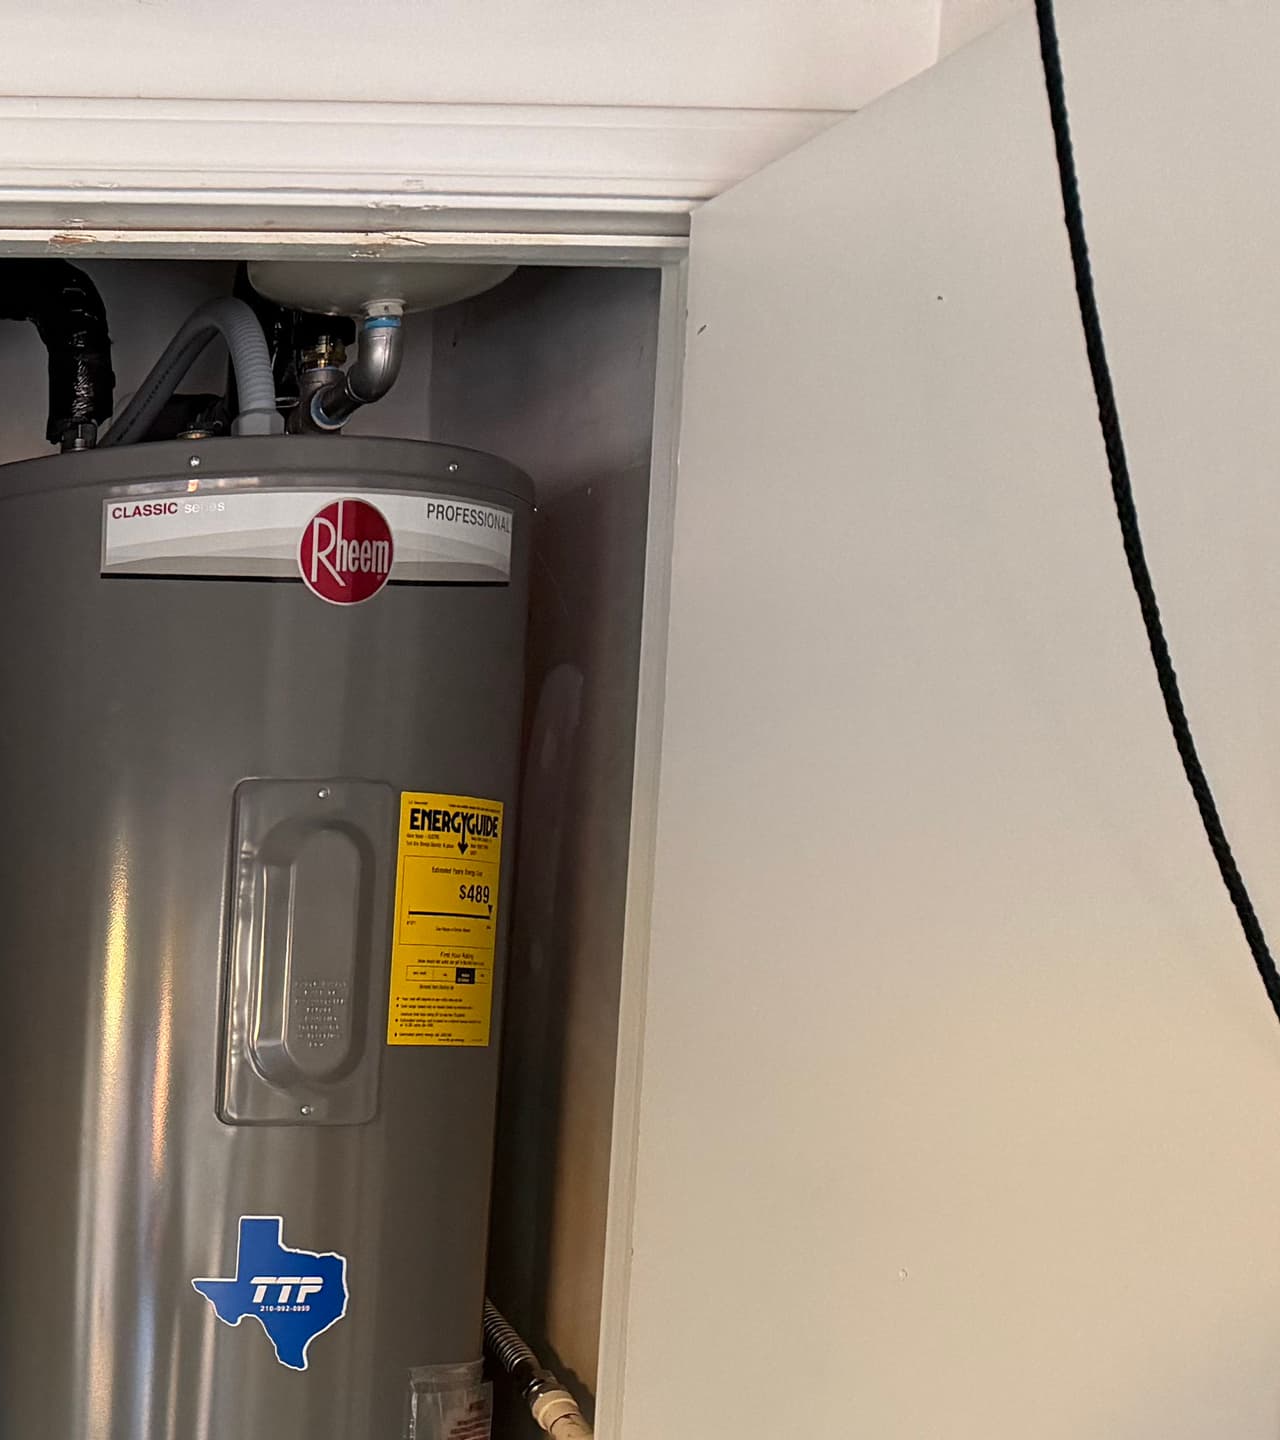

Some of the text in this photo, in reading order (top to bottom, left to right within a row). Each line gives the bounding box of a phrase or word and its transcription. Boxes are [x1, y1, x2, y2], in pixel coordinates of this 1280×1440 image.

[112, 502, 178, 520] CLASSIC
[426, 502, 510, 535] PROFESSIONAL
[310, 500, 390, 587] Rheem
[409, 807, 499, 840] ENERGYGUIDE
[459, 884, 491, 904] $489
[250, 1276, 324, 1303] TTP
